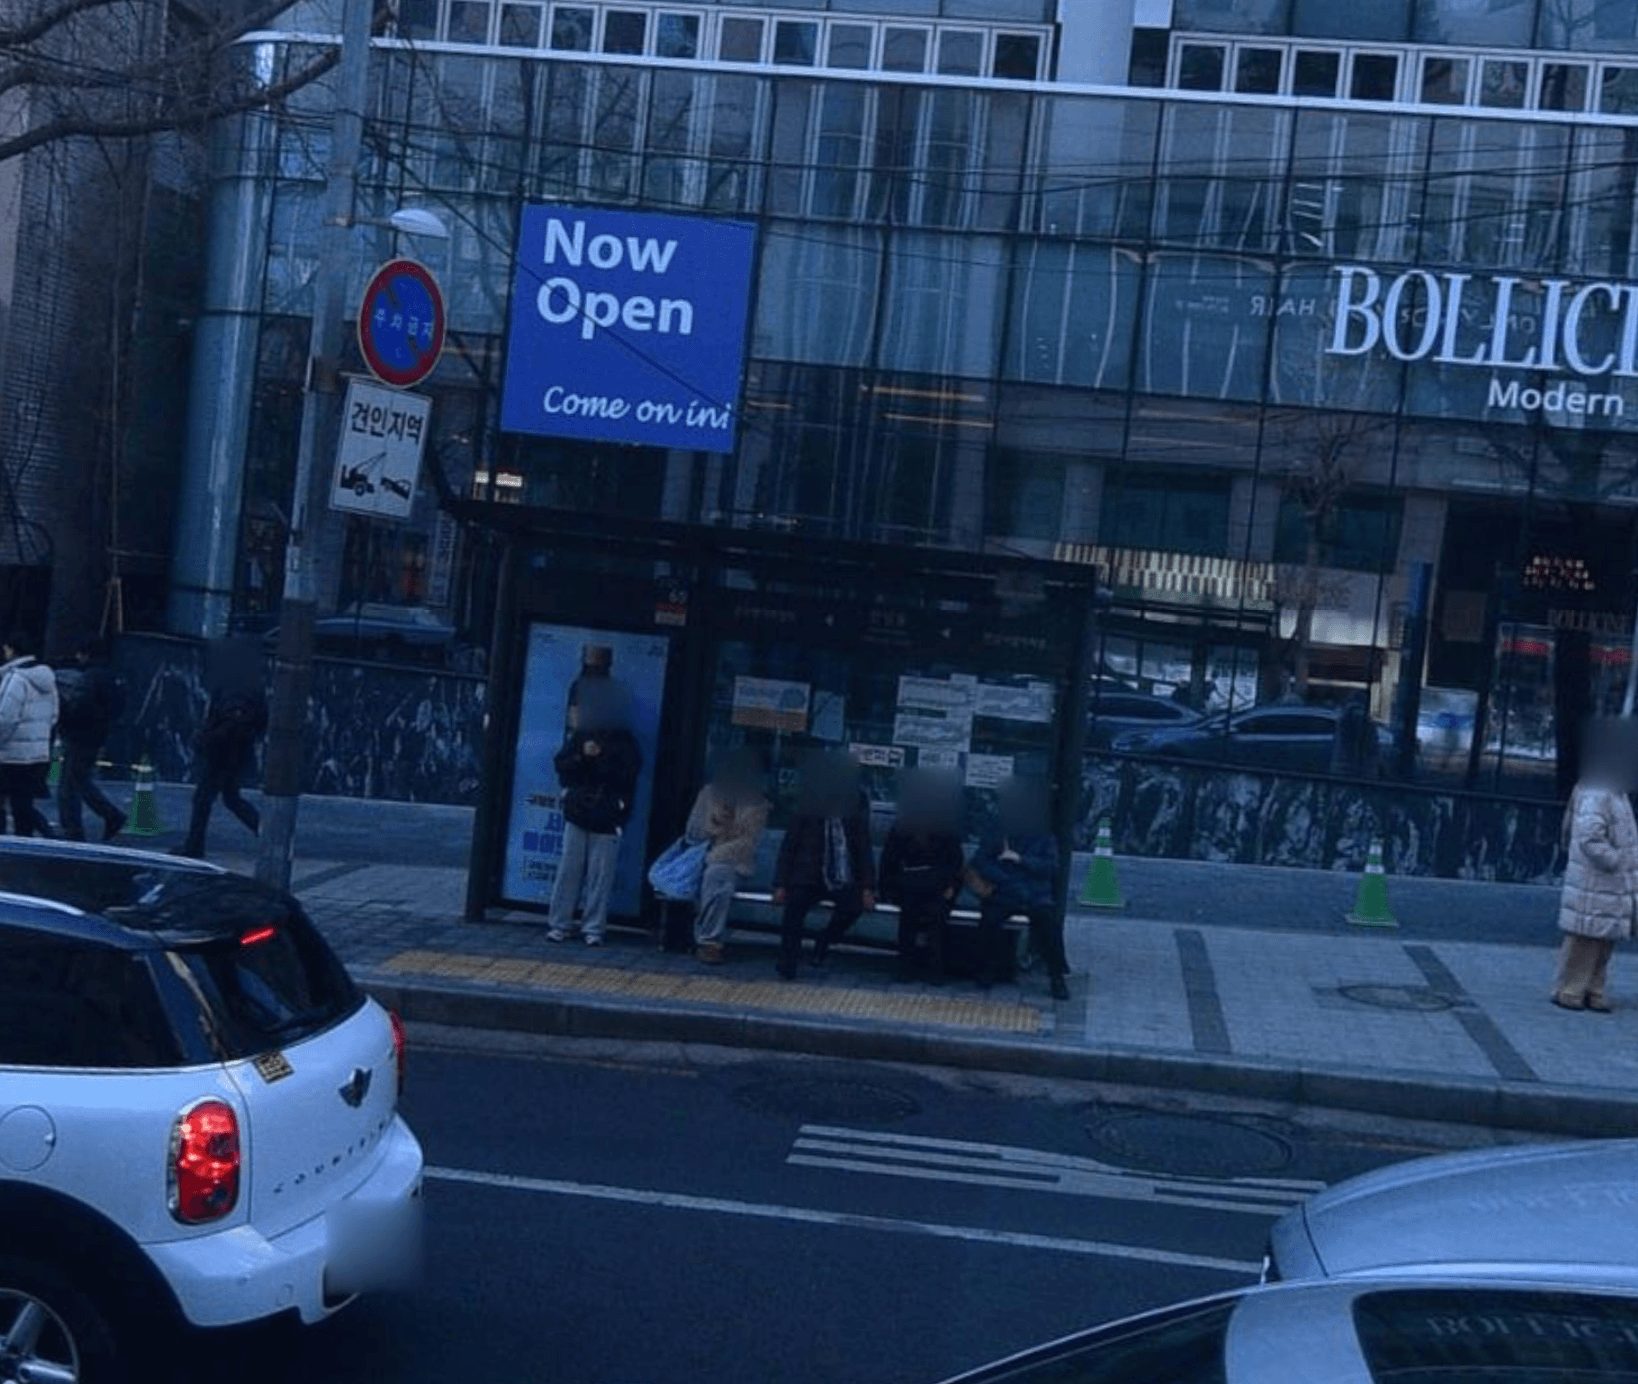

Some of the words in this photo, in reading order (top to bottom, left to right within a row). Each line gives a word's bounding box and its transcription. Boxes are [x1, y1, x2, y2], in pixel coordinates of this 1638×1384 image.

[543, 218, 678, 274] Now
[536, 276, 694, 340] Open
[543, 385, 631, 419] Come
[636, 400, 683, 424] on
[1488, 379, 1624, 417] Modern
[351, 402, 424, 446] 견인지역
